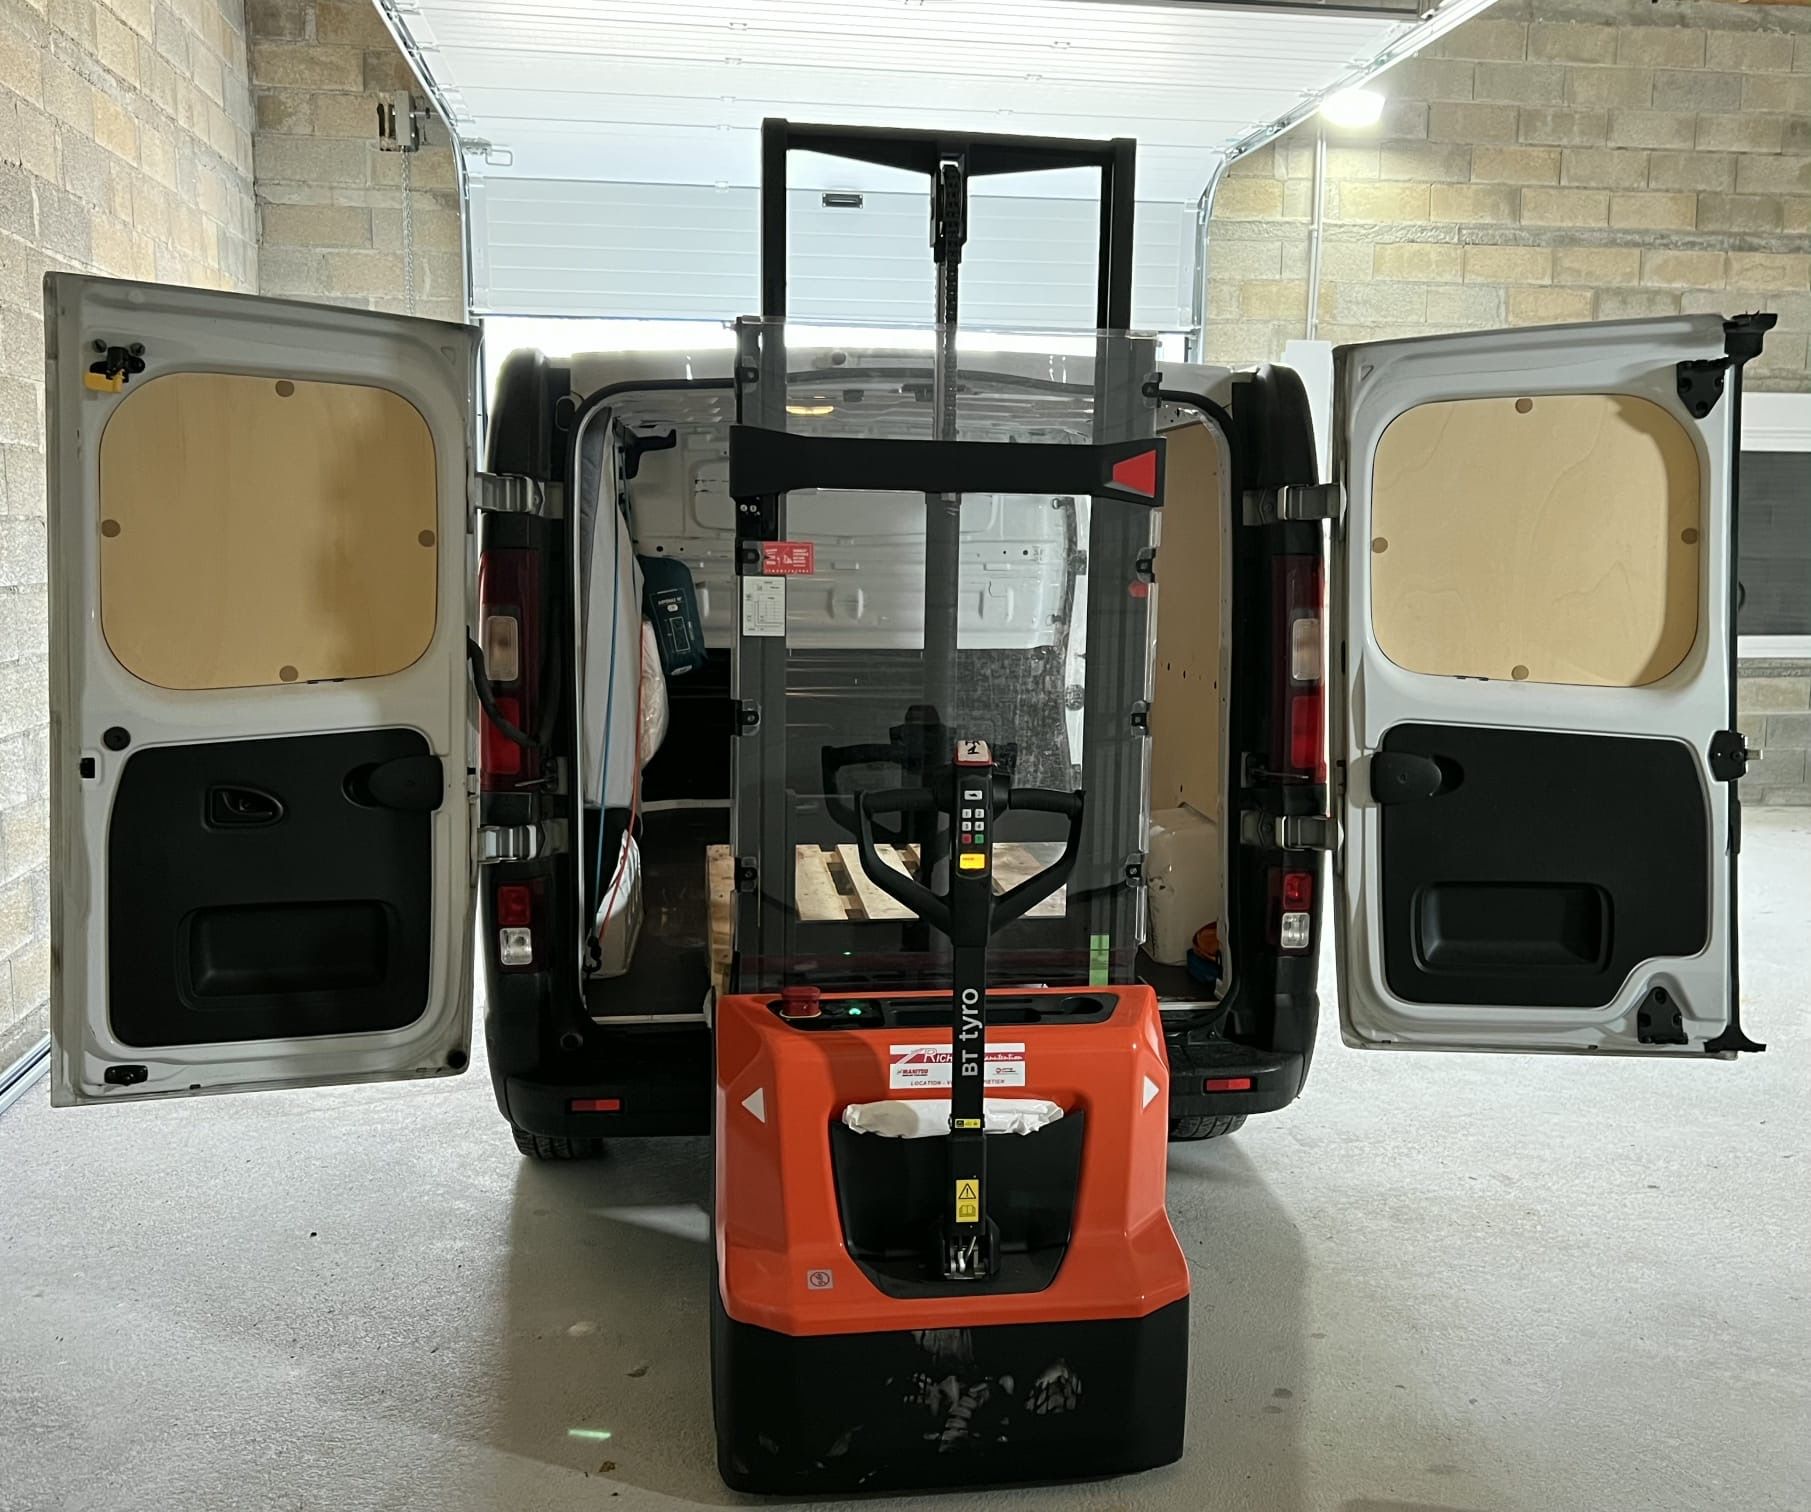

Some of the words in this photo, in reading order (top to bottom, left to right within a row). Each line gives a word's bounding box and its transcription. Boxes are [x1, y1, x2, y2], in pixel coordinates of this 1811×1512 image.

[959, 988, 983, 1042] tyro
[923, 1048, 952, 1063] RICH
[962, 1049, 979, 1076] BT
